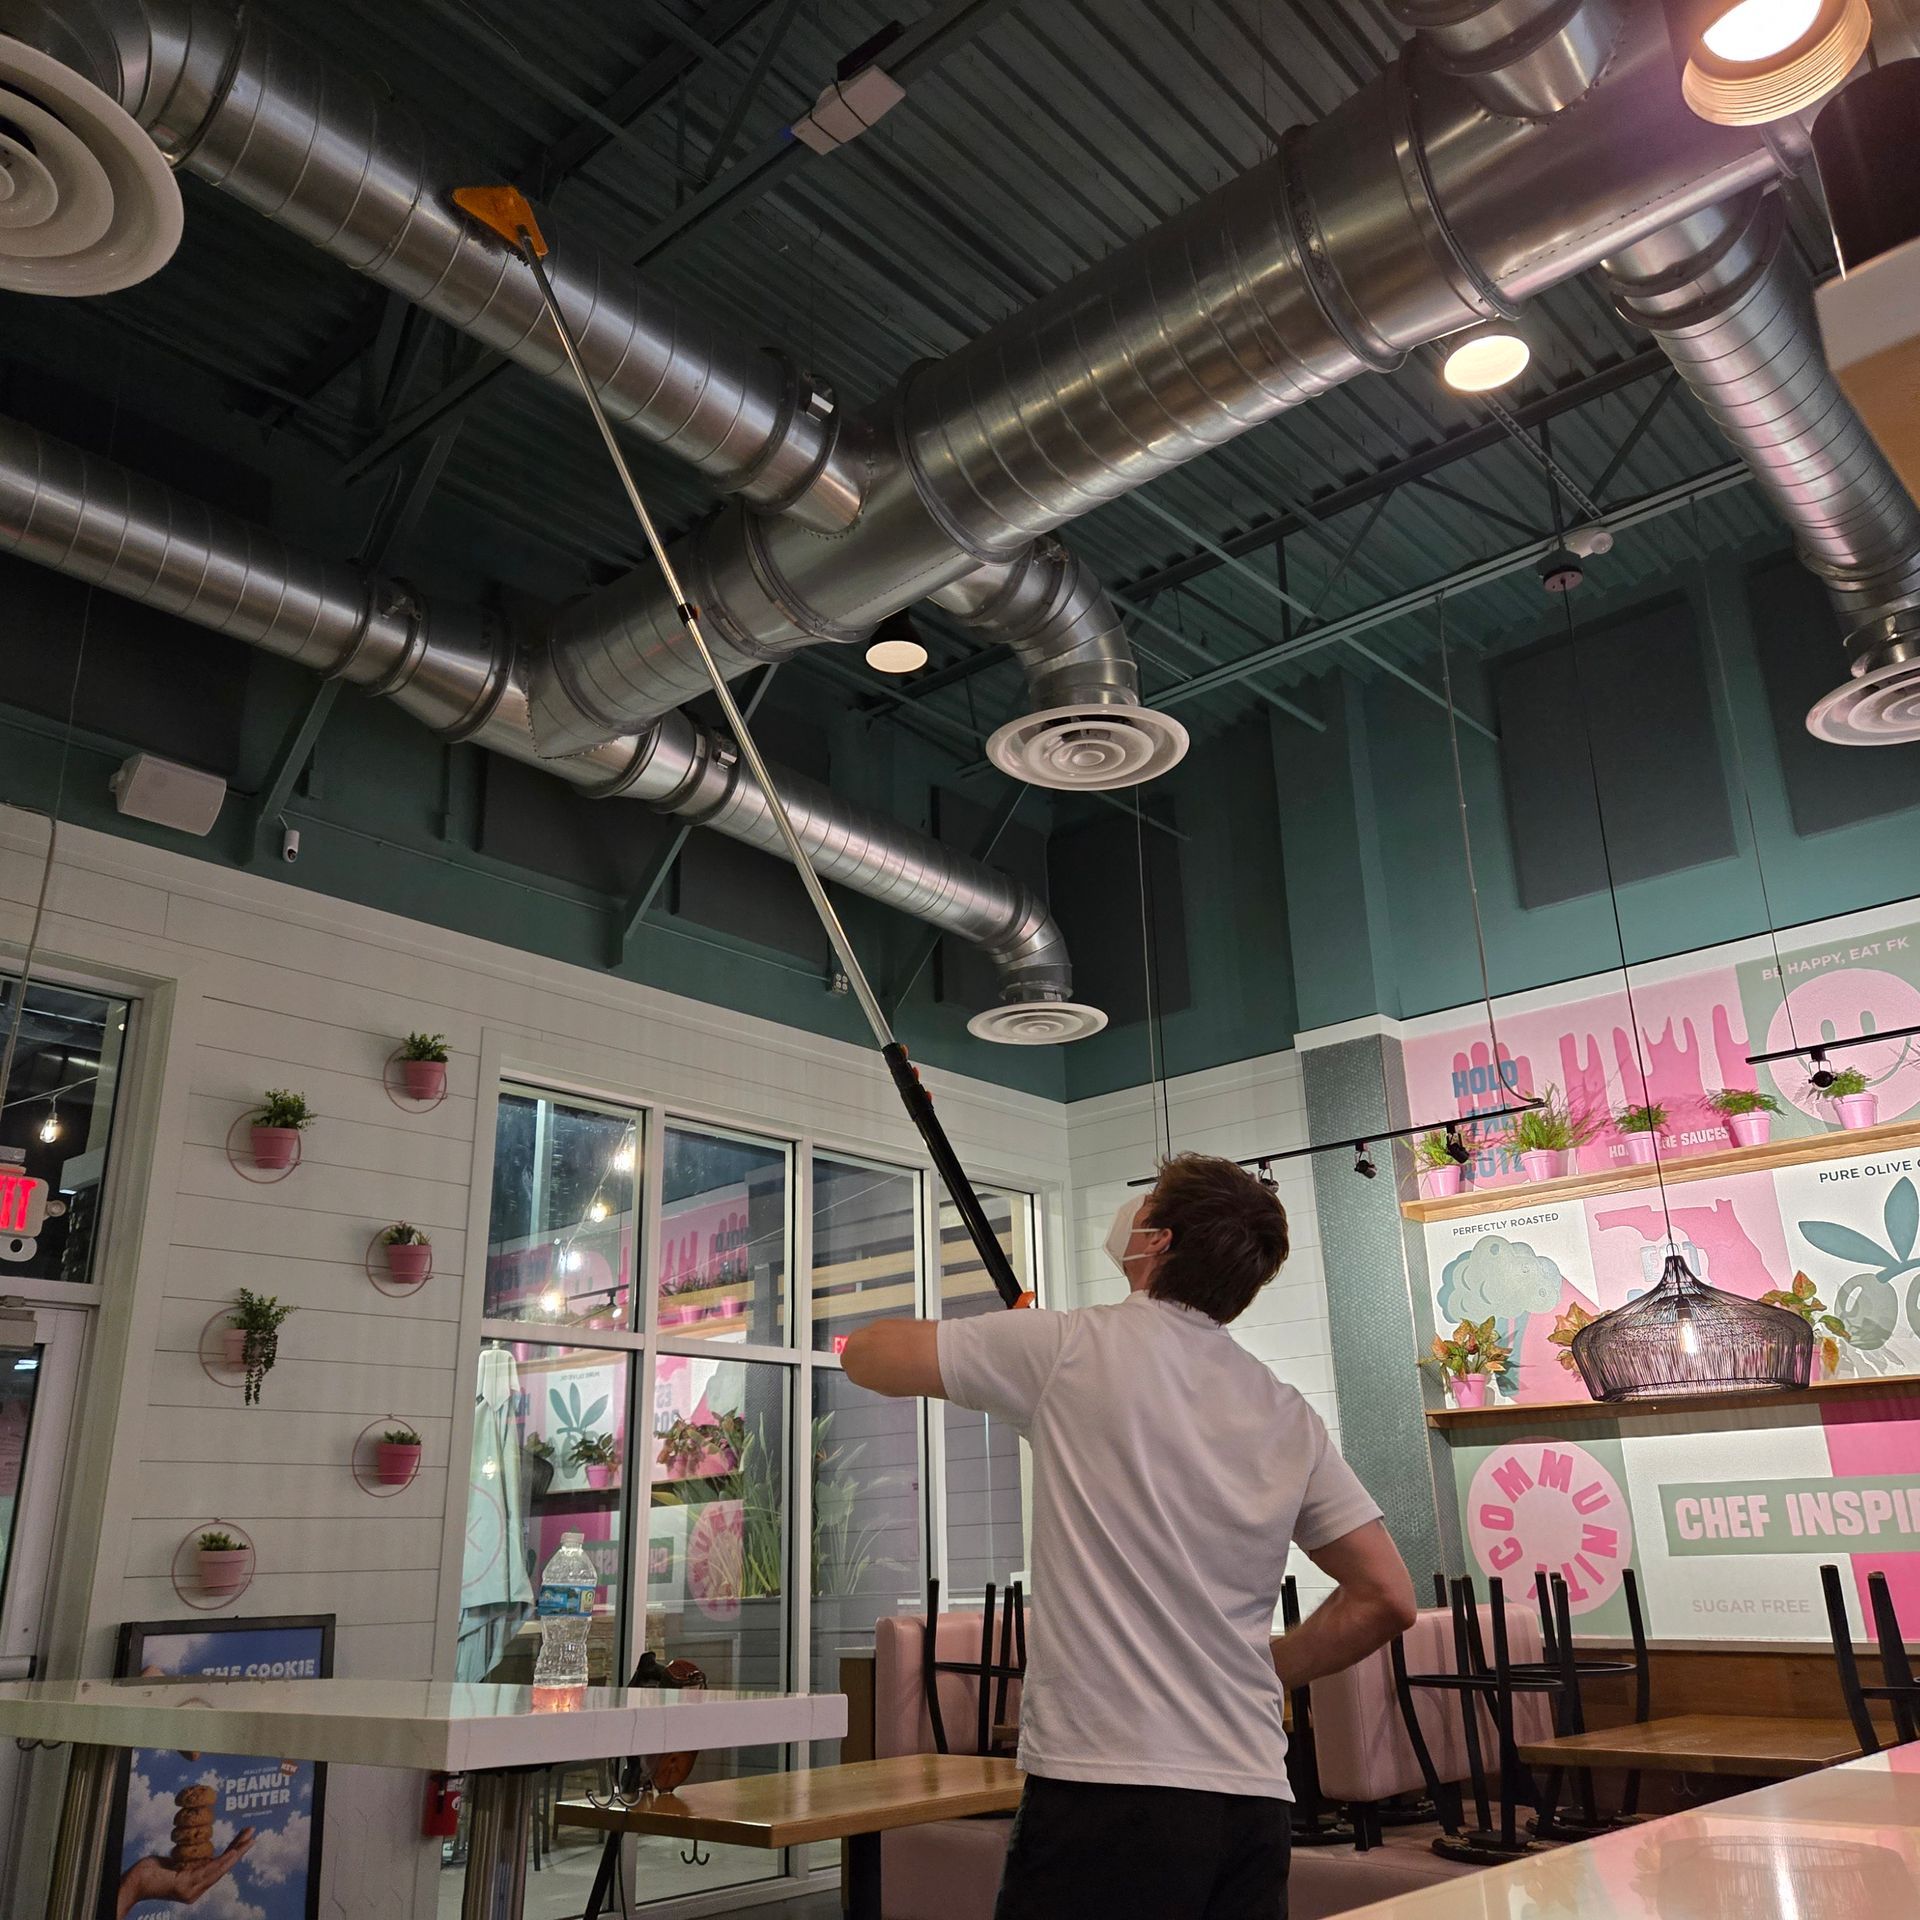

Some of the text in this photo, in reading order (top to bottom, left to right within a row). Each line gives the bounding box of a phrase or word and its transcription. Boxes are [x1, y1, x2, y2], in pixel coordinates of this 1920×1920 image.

[1762, 936, 1910, 981] BE HAPPY, EAT FK
[1452, 1059, 1519, 1098] HOLD
[1680, 1126, 1730, 1146] SAUCES
[1819, 1168, 1860, 1183] PURE
[1864, 1160, 1912, 1177] OLIVE
[0, 1175, 38, 1231] IT
[1453, 1212, 1559, 1236] PERFECTLY ROASTED
[1675, 1495, 1771, 1540] CHEF
[1692, 1599, 1811, 1613] SUGAR FREE
[245, 1659, 315, 1678] COOKIE
[225, 1773, 290, 1794] PEANUT
[225, 1788, 291, 1811] BUTTER
